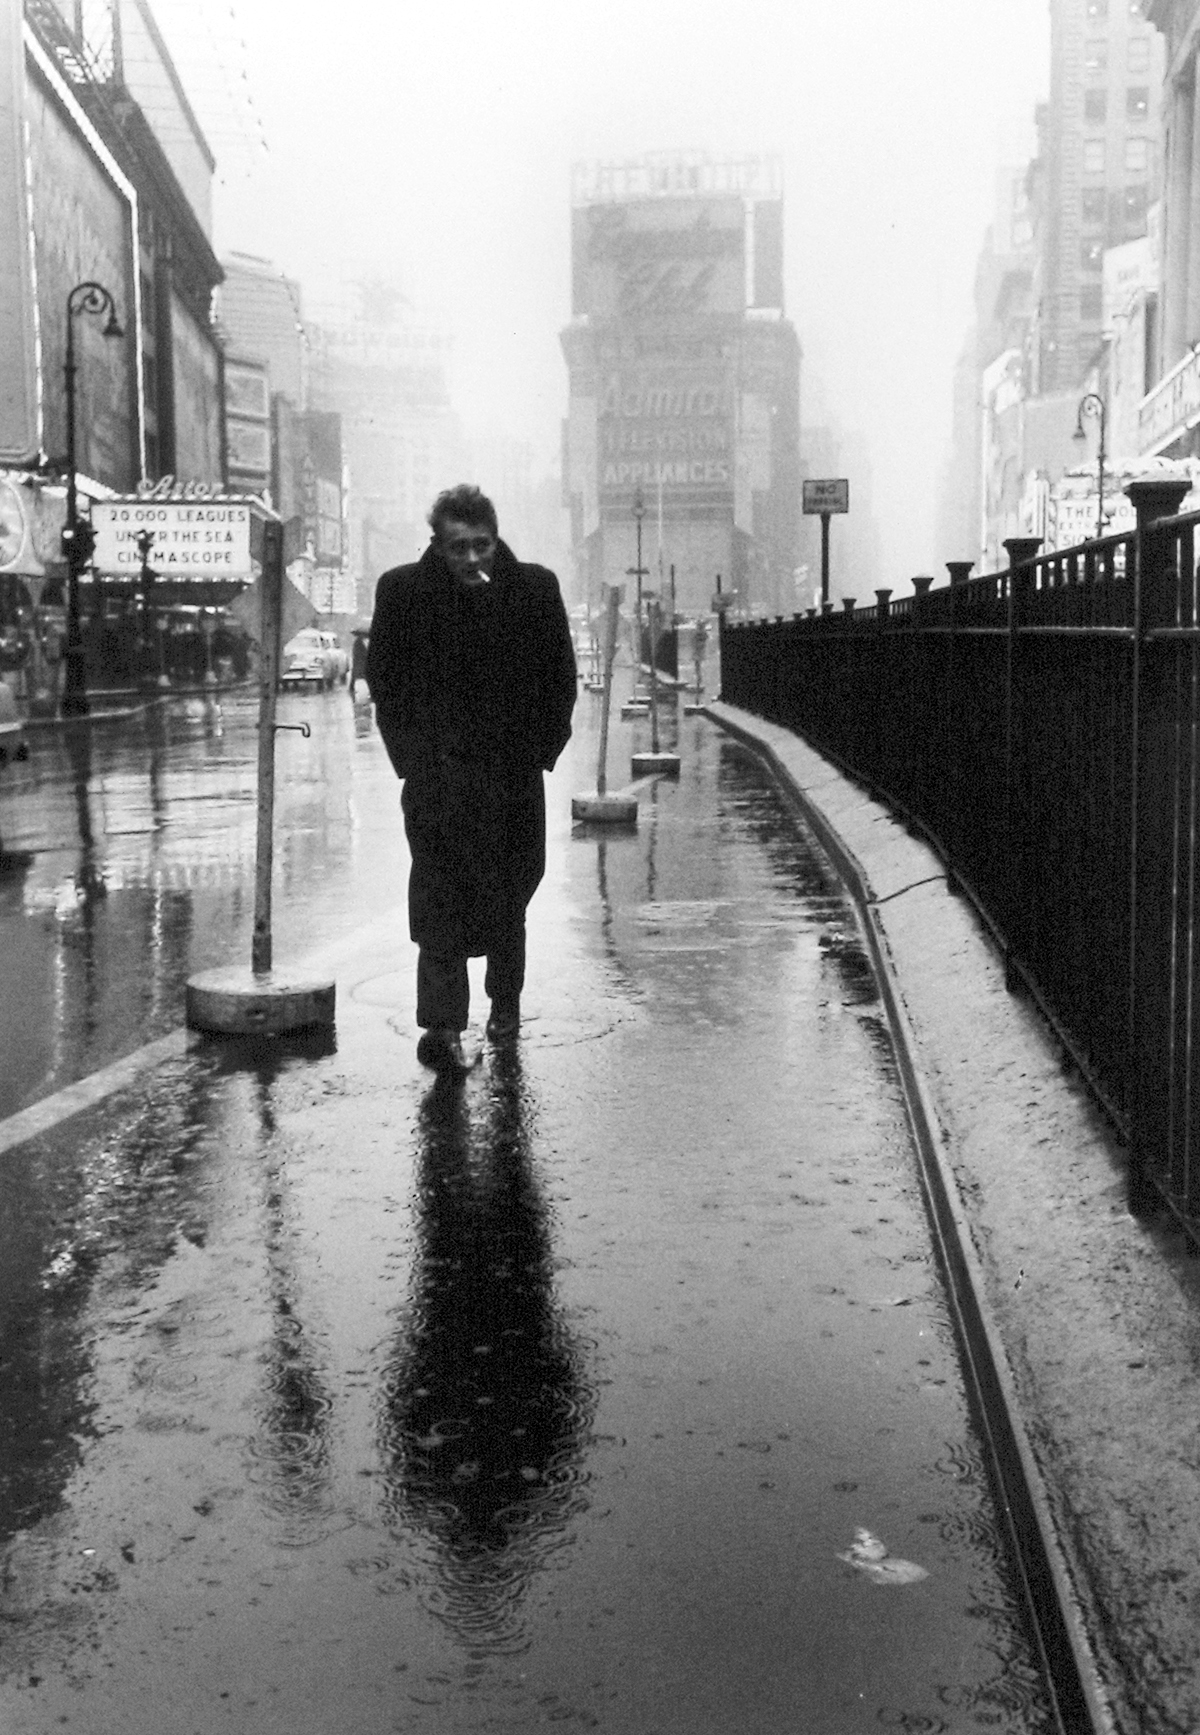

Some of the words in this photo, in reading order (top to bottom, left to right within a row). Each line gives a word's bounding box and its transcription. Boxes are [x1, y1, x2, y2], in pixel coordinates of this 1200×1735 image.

[603, 459, 730, 484] APPLIANCES
[137, 474, 225, 497] Astor
[814, 483, 837, 495] NO
[177, 510, 246, 522] LEAGUES
[1065, 506, 1094, 519] THE
[174, 531, 200, 543] THE
[204, 531, 234, 543] SEA
